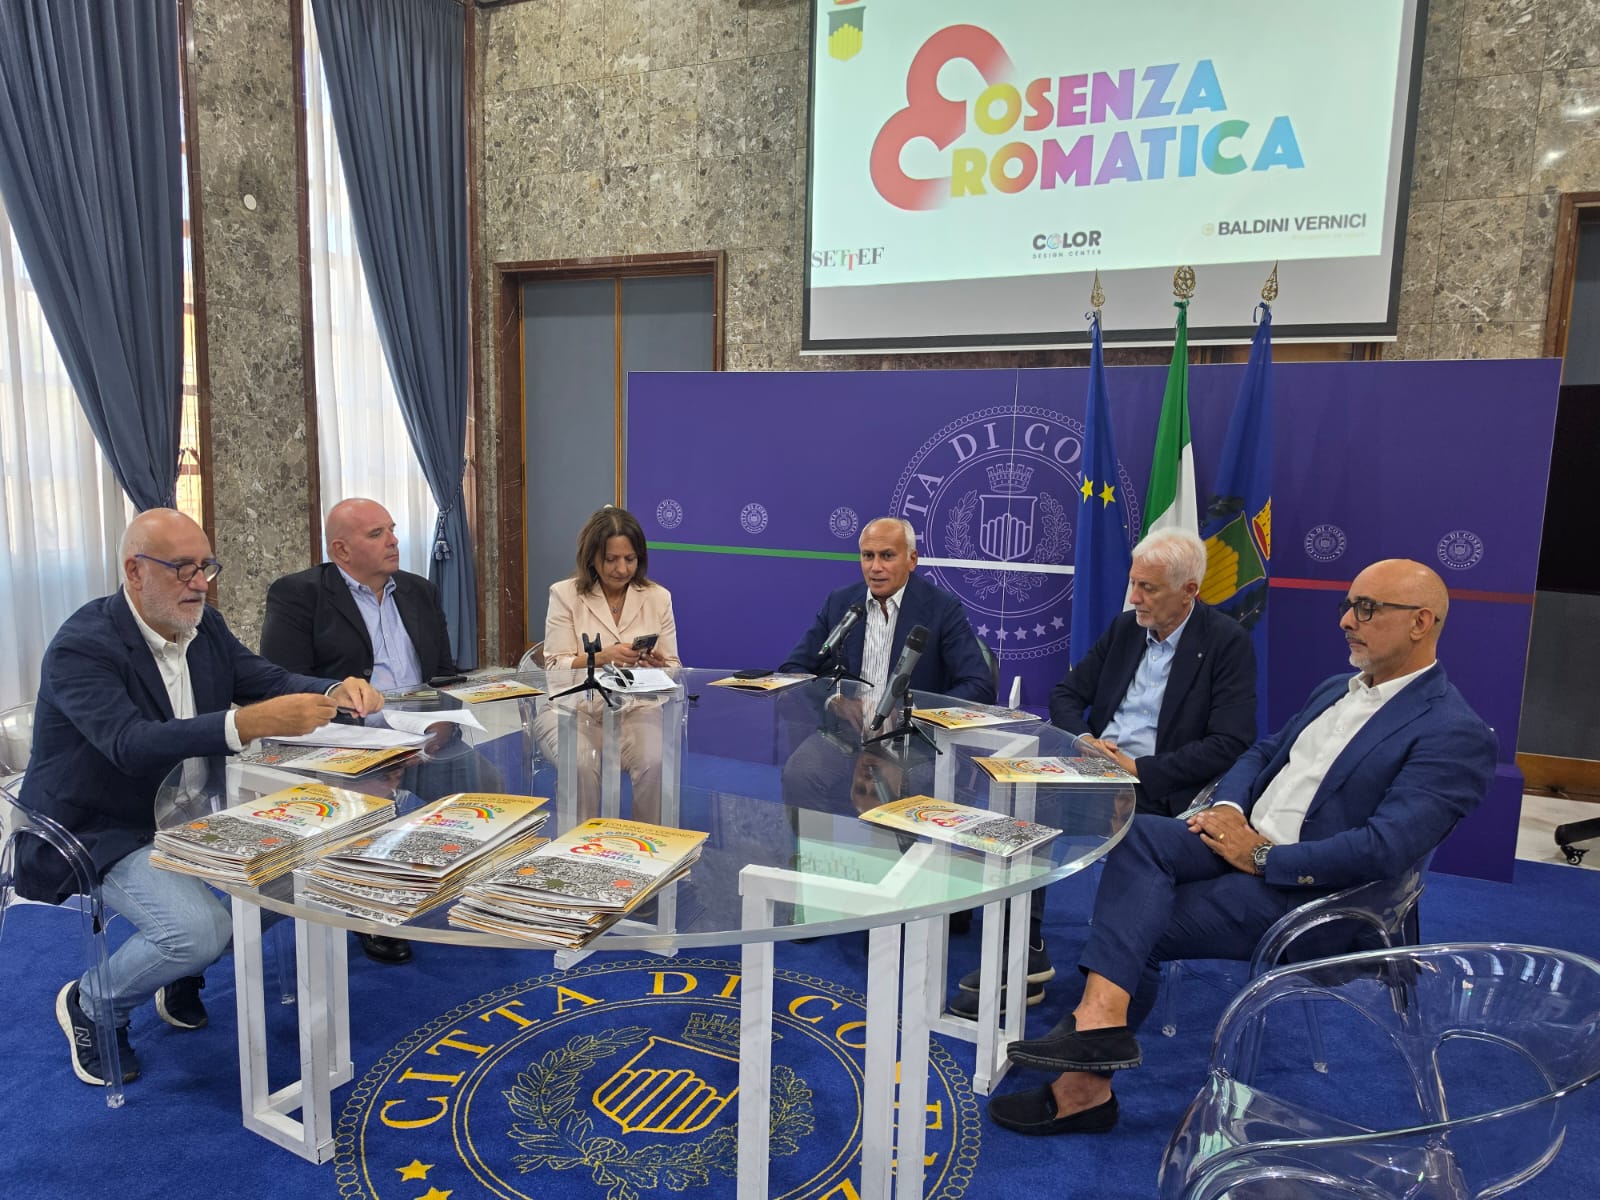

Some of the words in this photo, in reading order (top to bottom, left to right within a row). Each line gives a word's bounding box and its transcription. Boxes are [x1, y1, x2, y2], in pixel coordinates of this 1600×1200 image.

[1217, 217, 1290, 236] BALDINI
[1294, 213, 1367, 231] VERNICI
[1032, 230, 1102, 250] COLOR
[811, 246, 885, 272] SETTEF
[1032, 252, 1064, 260] DESIGN
[1068, 249, 1102, 257] CENTER
[948, 422, 1000, 464] DI
[380, 984, 605, 1129] CITTA
[646, 971, 741, 999] DI
